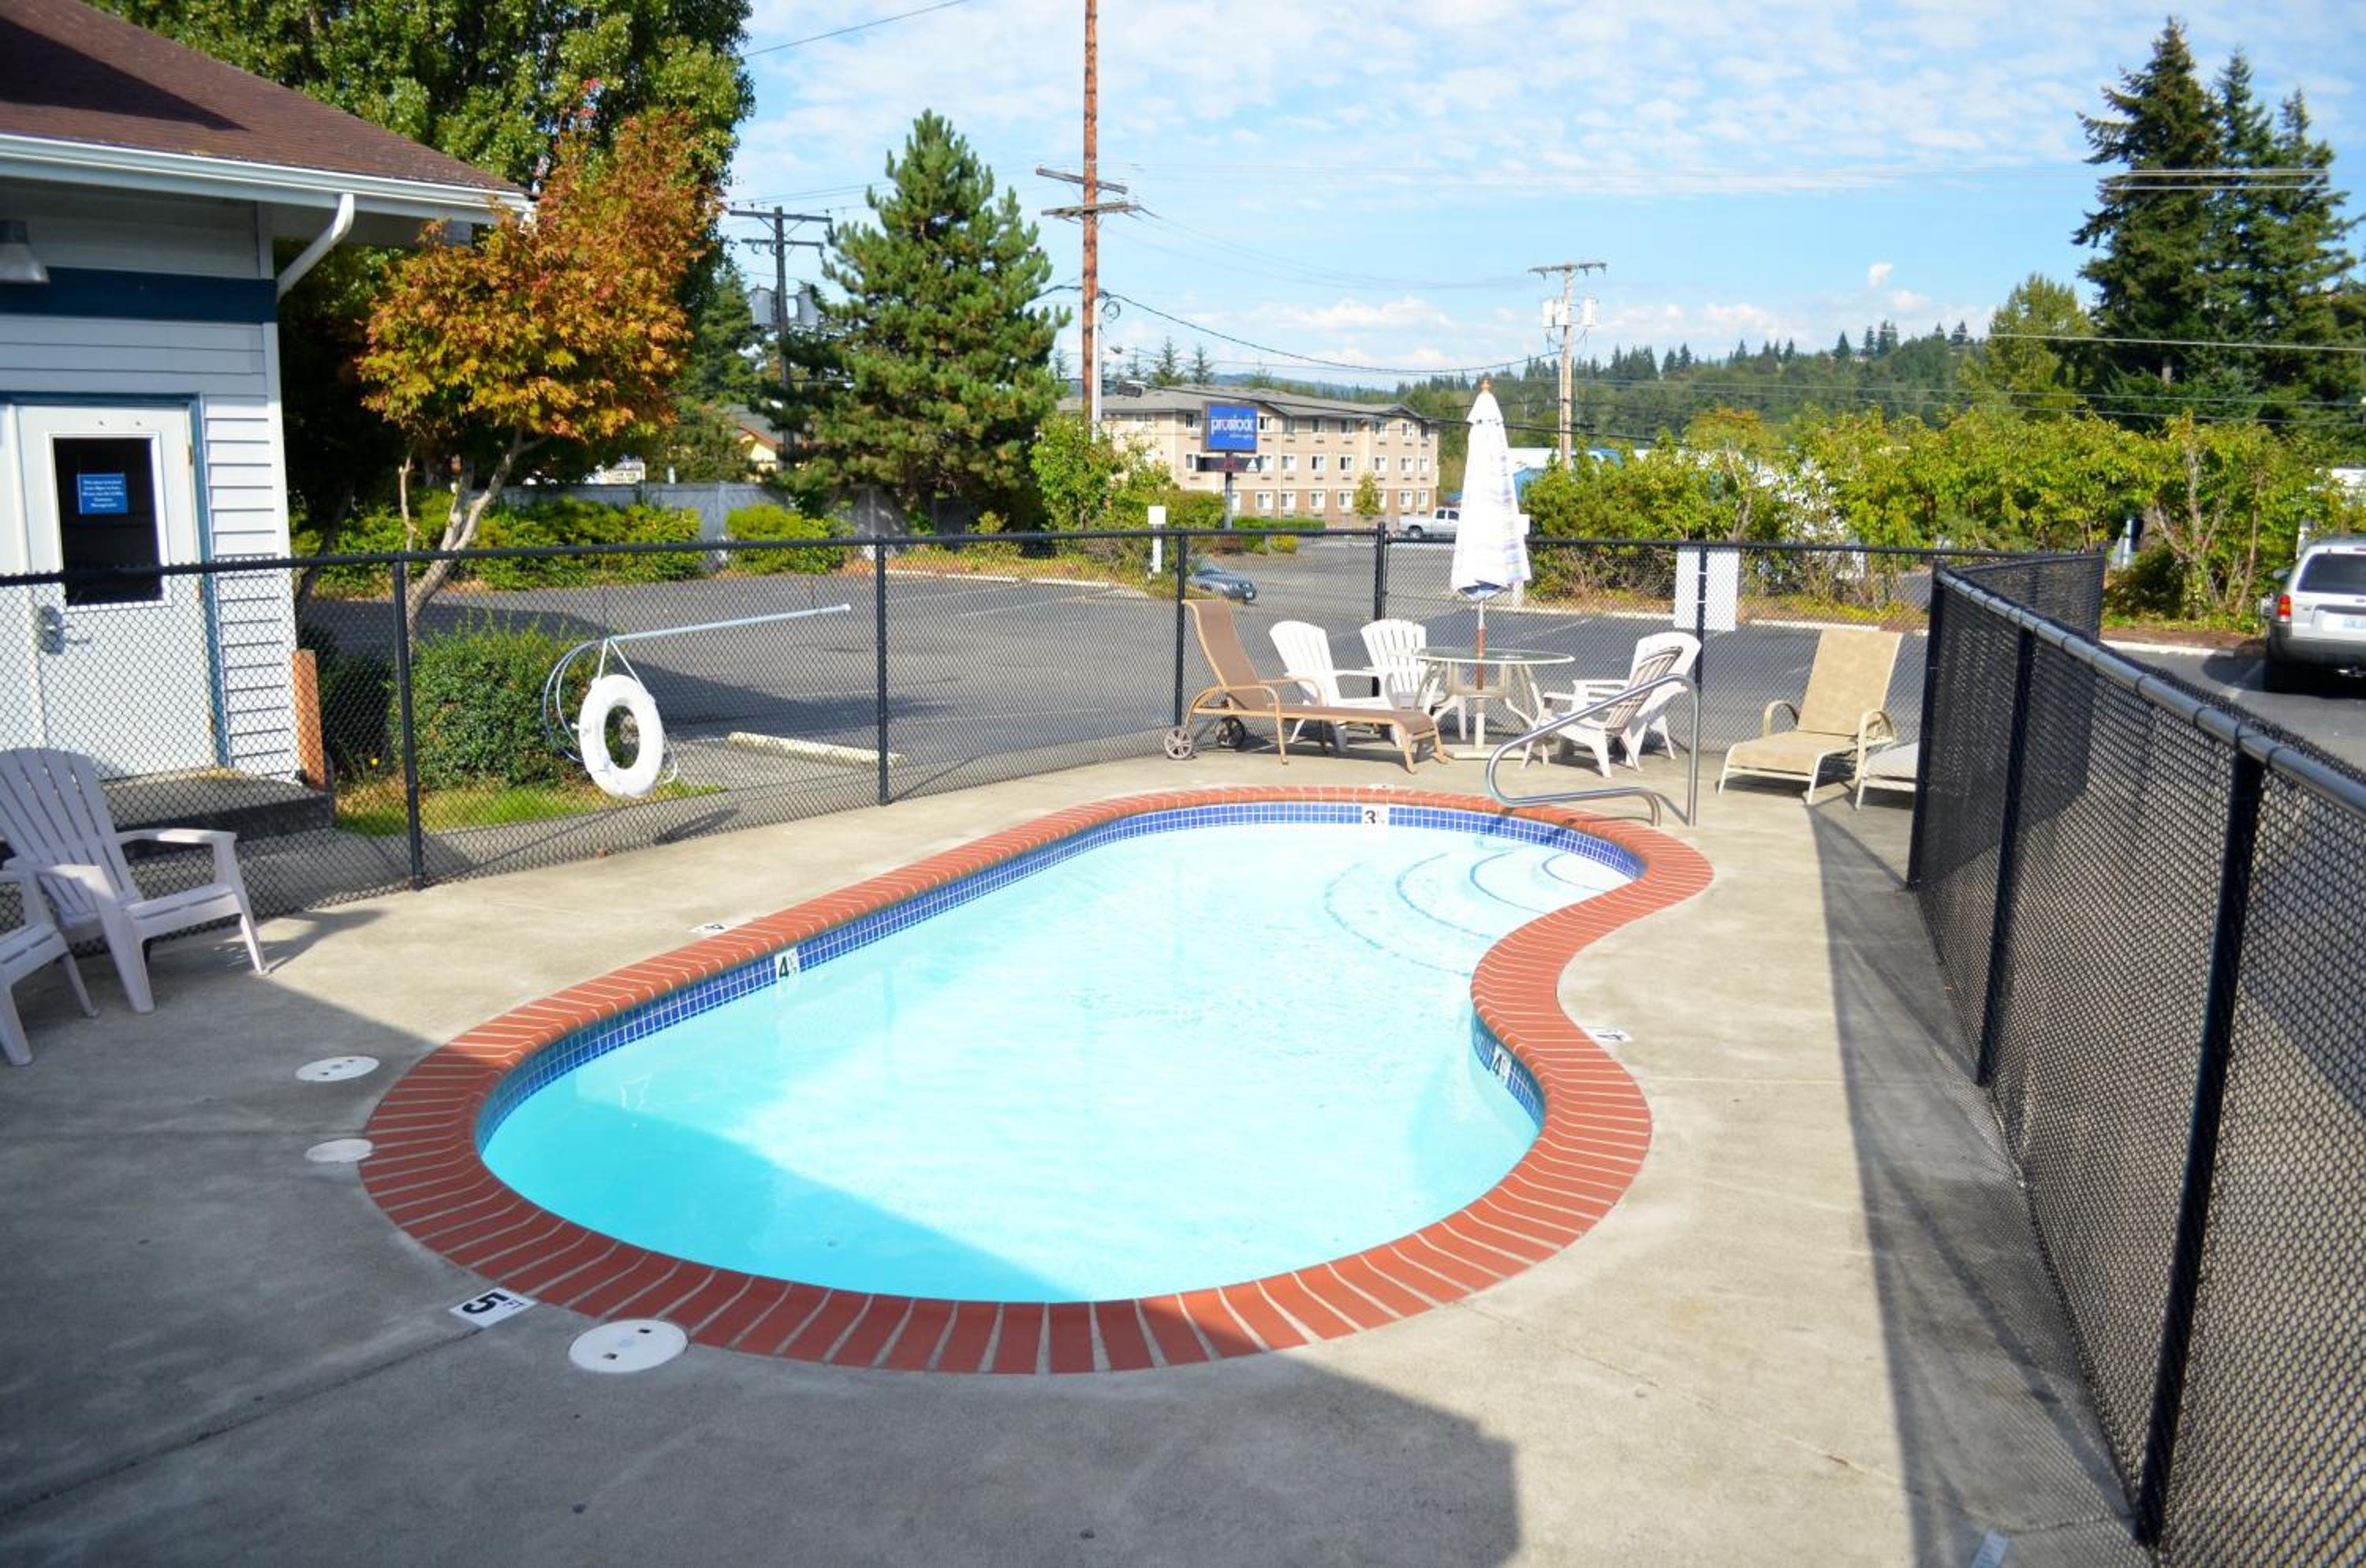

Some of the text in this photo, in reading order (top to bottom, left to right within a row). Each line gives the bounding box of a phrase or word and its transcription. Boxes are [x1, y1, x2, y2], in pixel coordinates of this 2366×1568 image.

[1364, 809, 1376, 824] 3
[778, 955, 789, 979] 4
[1492, 1053, 1502, 1076] 4
[461, 1291, 510, 1315] 5
